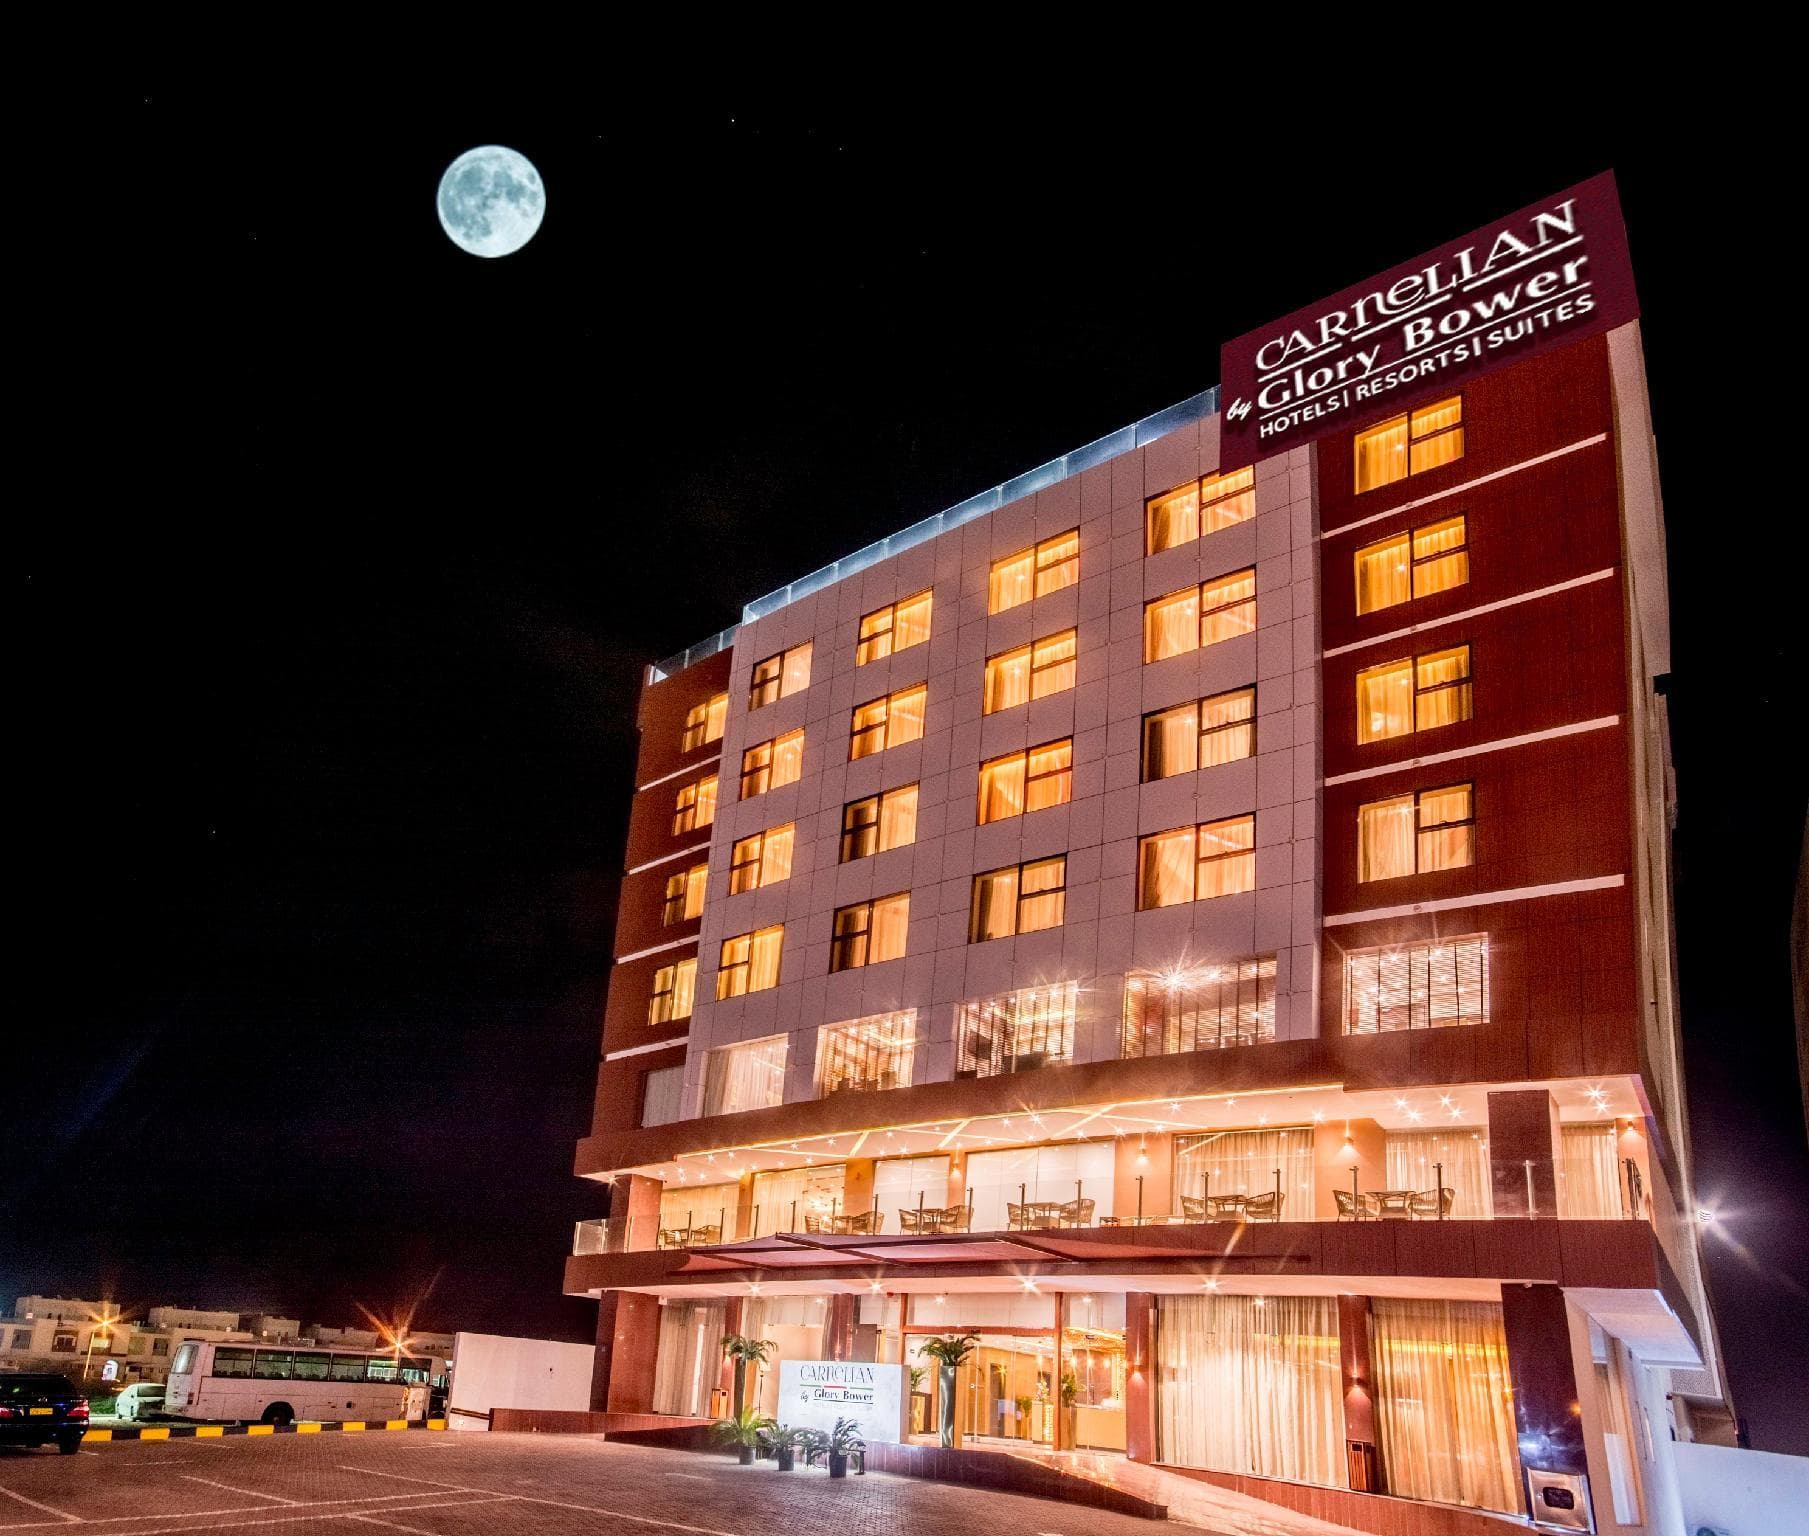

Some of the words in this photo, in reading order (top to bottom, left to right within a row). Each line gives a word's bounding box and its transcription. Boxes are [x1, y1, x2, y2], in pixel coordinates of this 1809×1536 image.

[1226, 396, 1252, 421] by
[1257, 344, 1381, 410] Glory
[1402, 255, 1589, 352] Bower
[1486, 293, 1597, 348] SUITES
[814, 1388, 840, 1400] Glory
[843, 1390, 874, 1401] Bower
